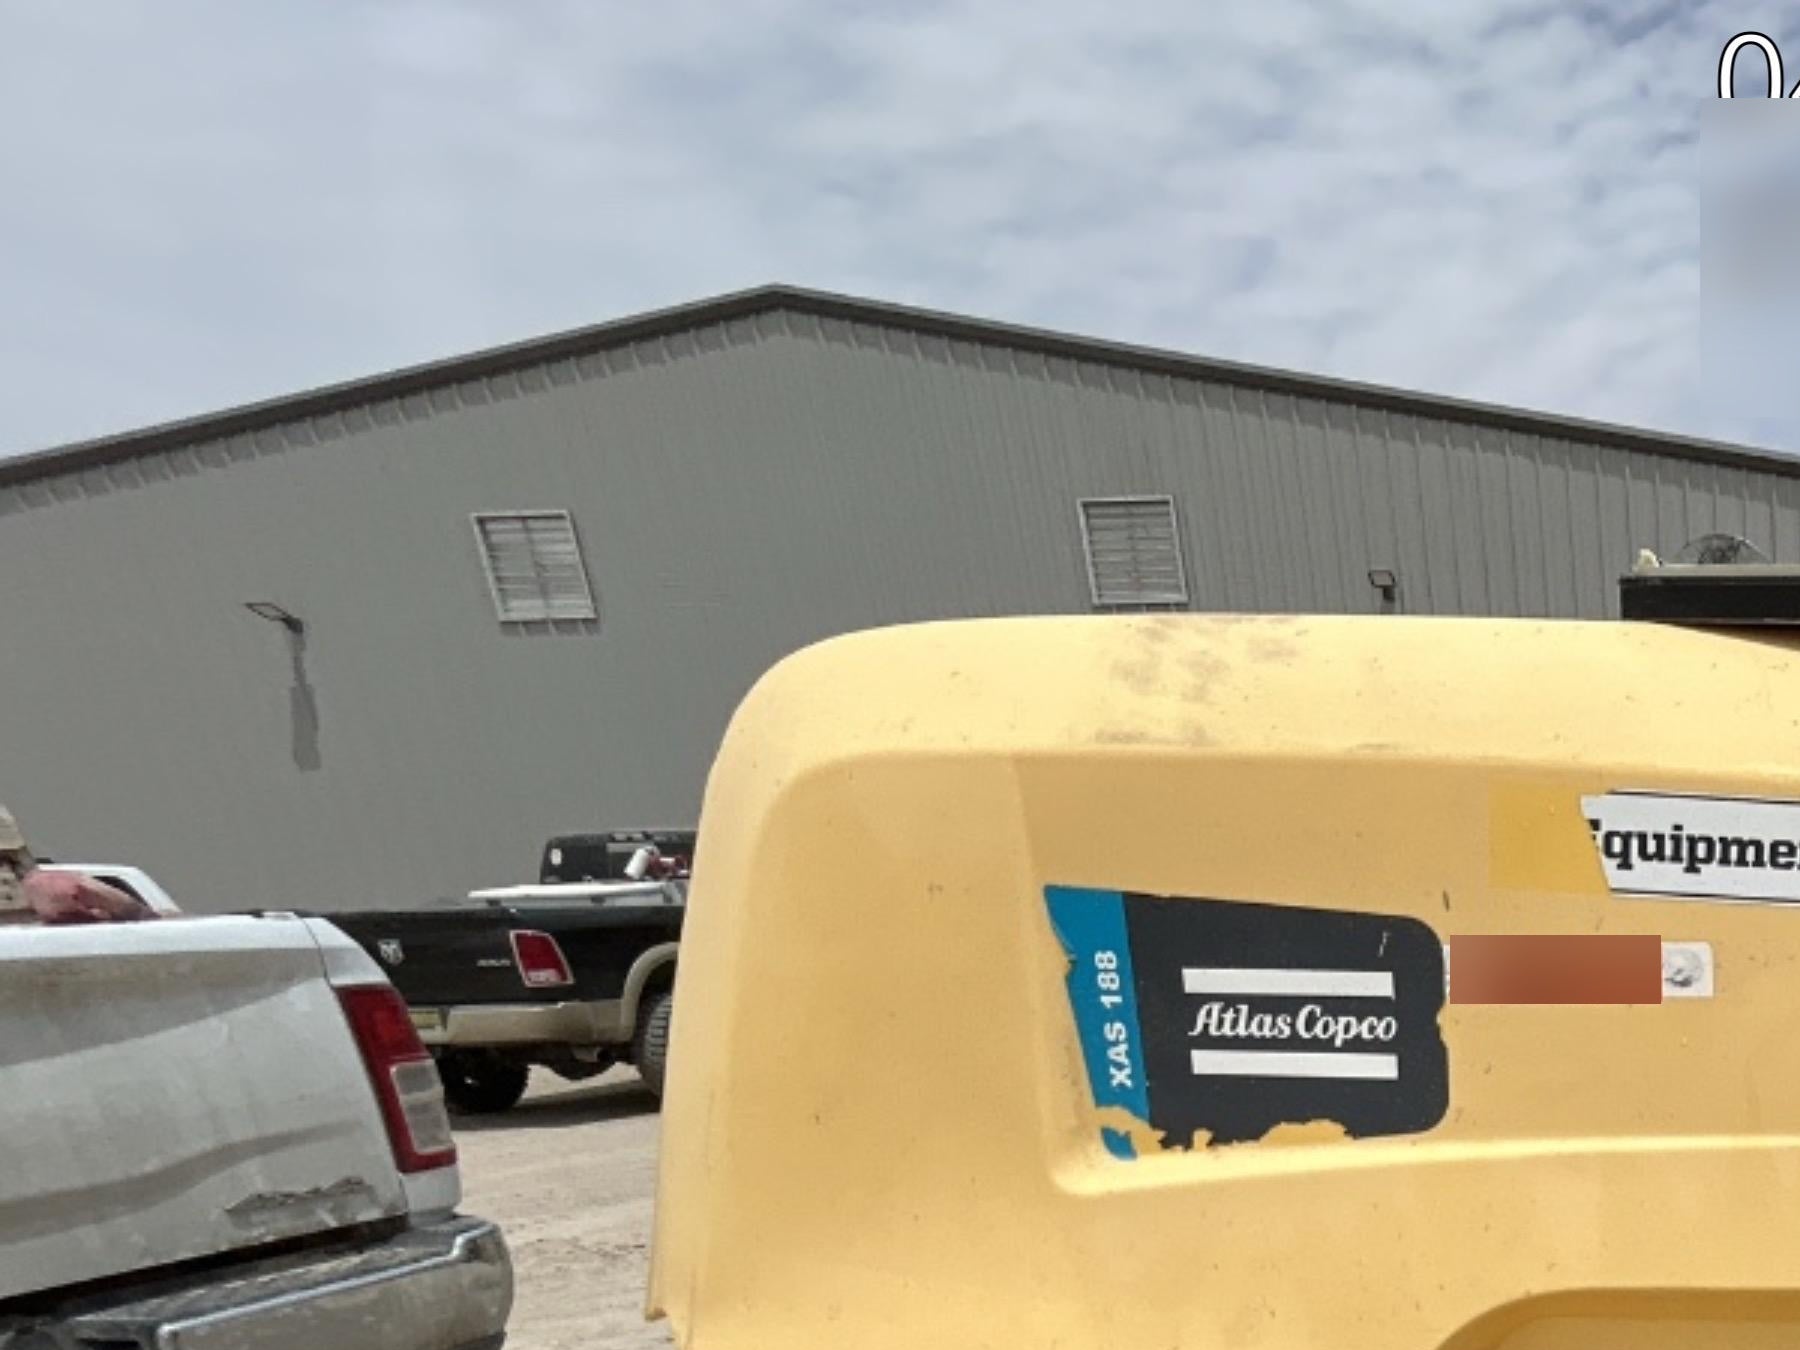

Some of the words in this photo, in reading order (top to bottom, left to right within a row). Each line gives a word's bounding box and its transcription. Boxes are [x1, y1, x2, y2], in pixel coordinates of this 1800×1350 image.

[1094, 950, 1123, 1009] 188
[1187, 1001, 1292, 1039] Atlas
[1295, 1003, 1398, 1048] Copco
[1104, 1021, 1133, 1088] XAS
